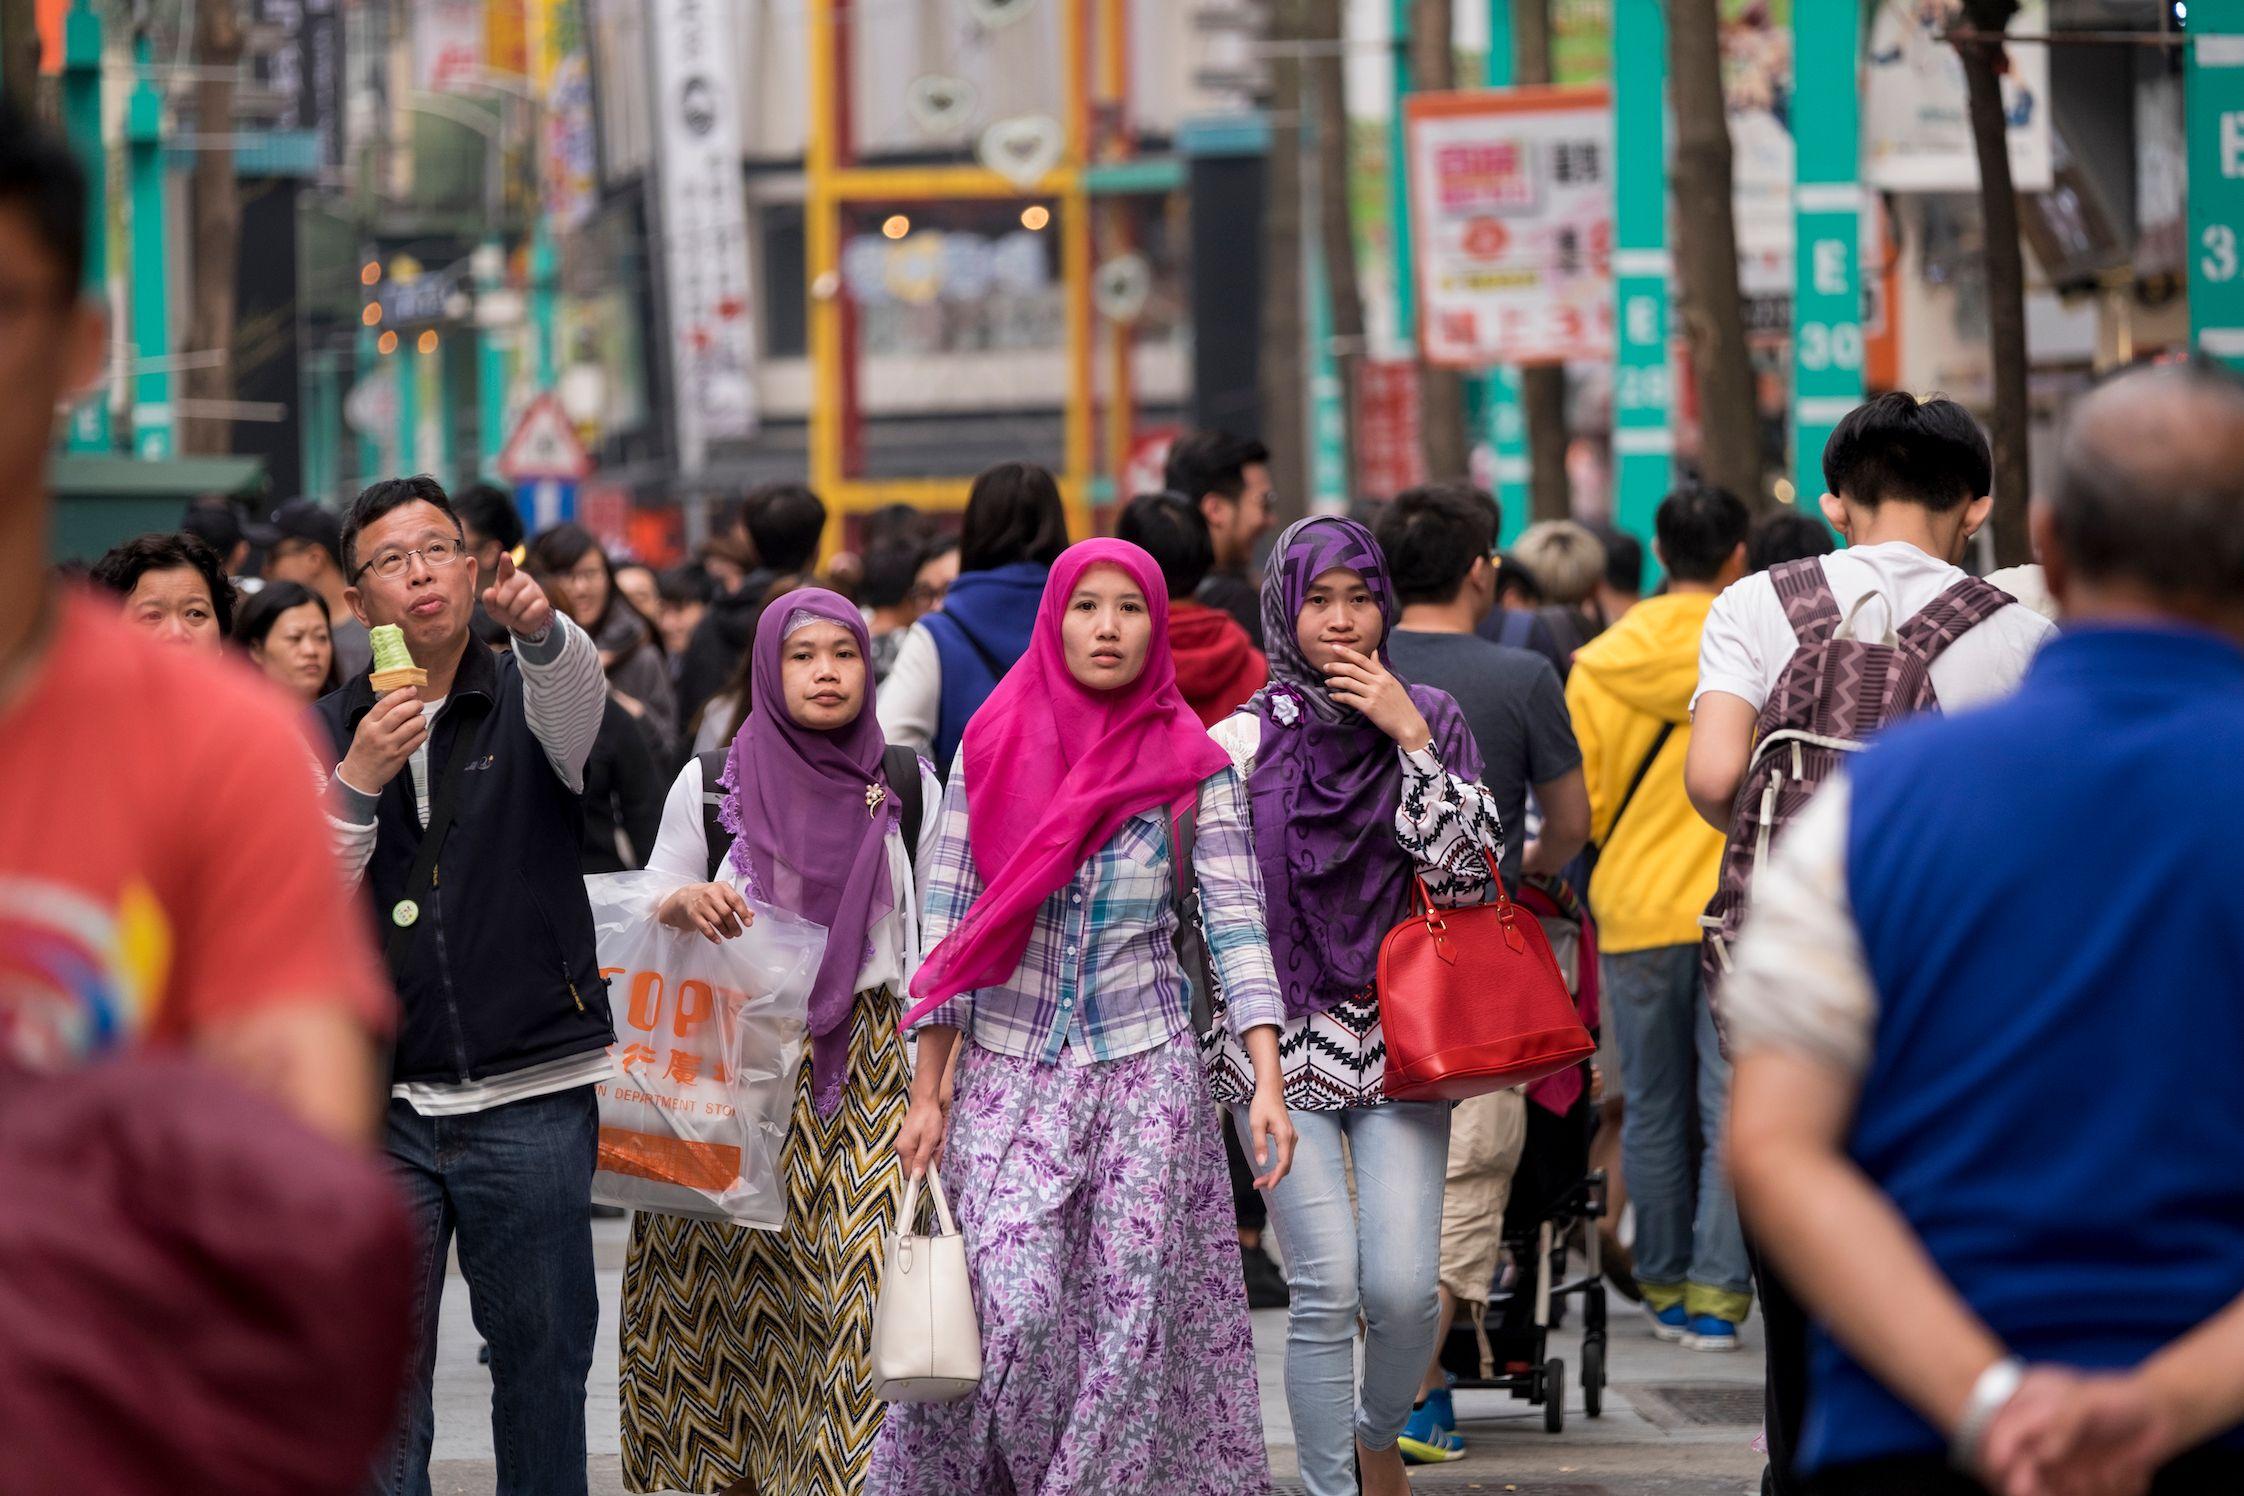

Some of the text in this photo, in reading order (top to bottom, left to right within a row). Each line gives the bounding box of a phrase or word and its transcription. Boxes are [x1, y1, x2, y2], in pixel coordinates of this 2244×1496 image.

[1812, 238, 1849, 296] E
[1799, 320, 1864, 371] 30
[614, 1087, 697, 1113] DEPARTMENT
